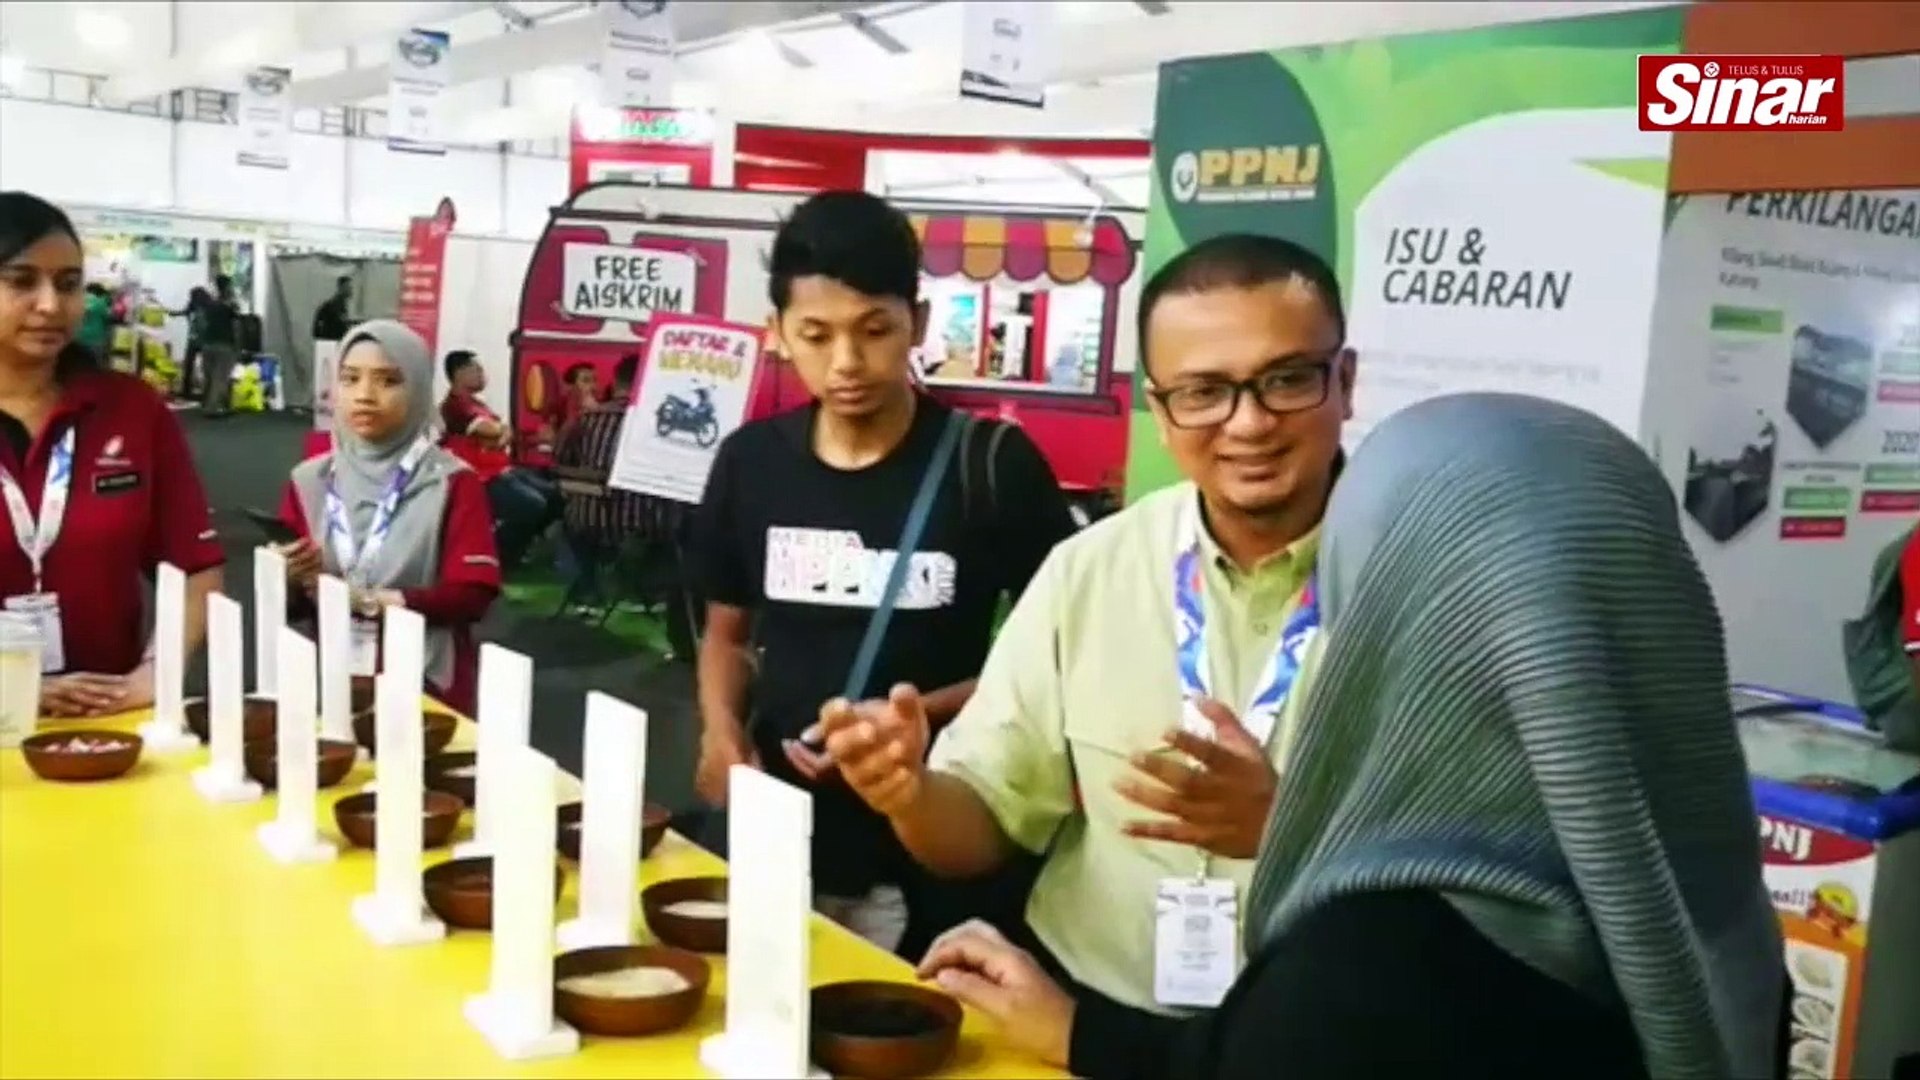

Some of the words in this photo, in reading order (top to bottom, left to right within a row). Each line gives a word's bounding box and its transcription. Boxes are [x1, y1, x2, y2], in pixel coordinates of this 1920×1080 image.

[1199, 144, 1321, 186] PPNJ
[1726, 190, 1920, 239] PERKILANGA
[1384, 226, 1449, 265] ISU
[1457, 226, 1487, 266] &
[595, 255, 662, 281] FREE
[574, 281, 682, 312] AISKRIM
[1383, 268, 1572, 310] CABARAN
